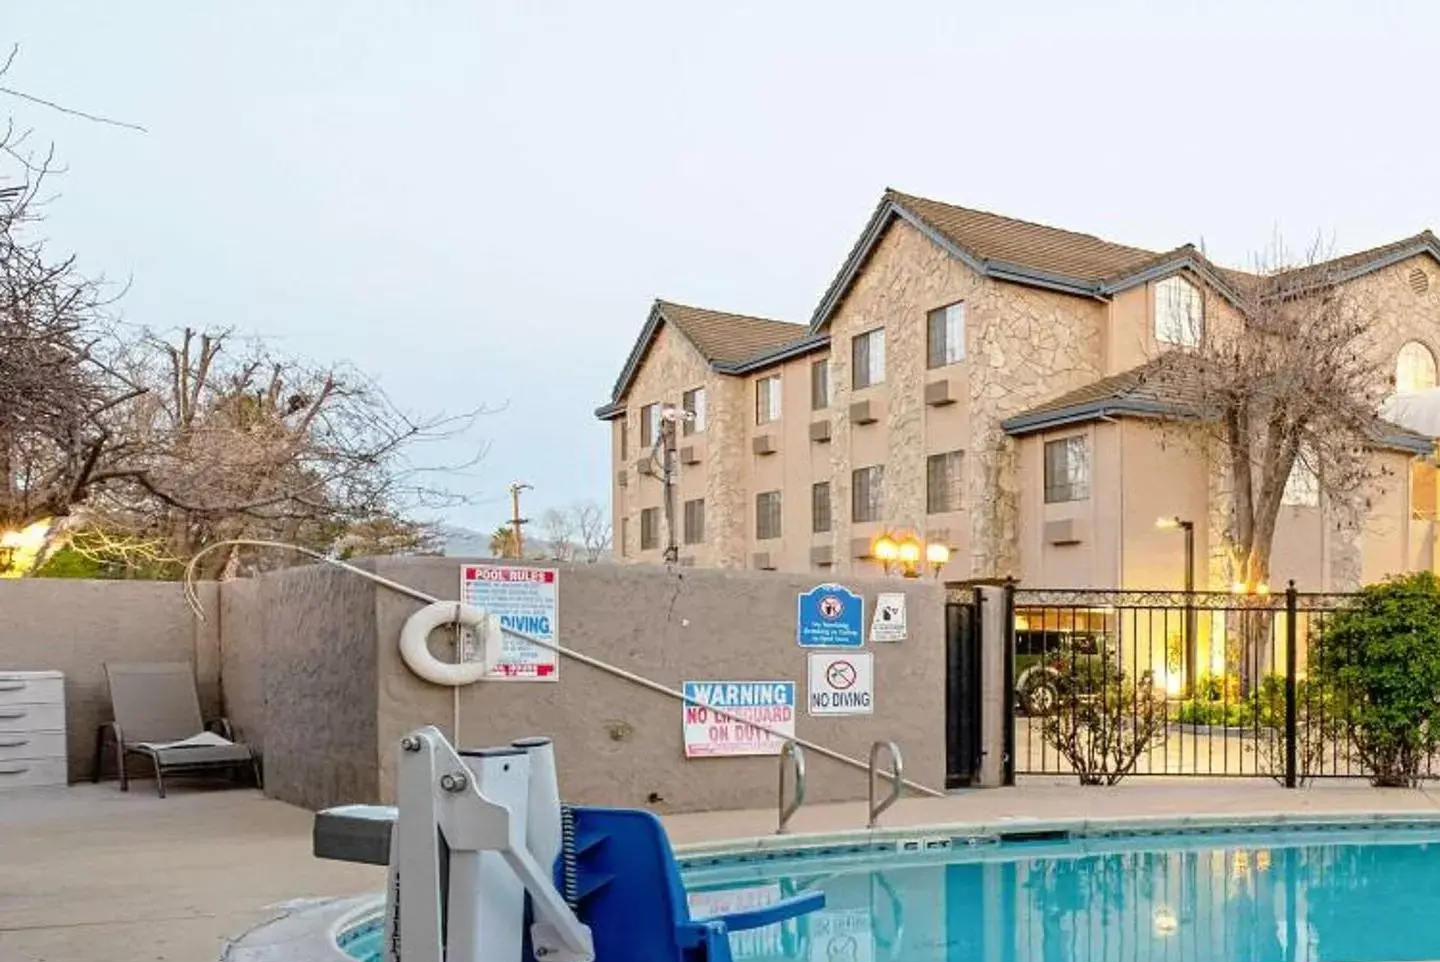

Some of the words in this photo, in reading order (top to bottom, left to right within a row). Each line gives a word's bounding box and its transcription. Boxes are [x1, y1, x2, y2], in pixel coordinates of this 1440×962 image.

[693, 684, 787, 705] WARNING
[813, 692, 830, 707] NO
[833, 692, 870, 707] DIVING
[687, 707, 707, 724] NO
[708, 726, 728, 742] ON
